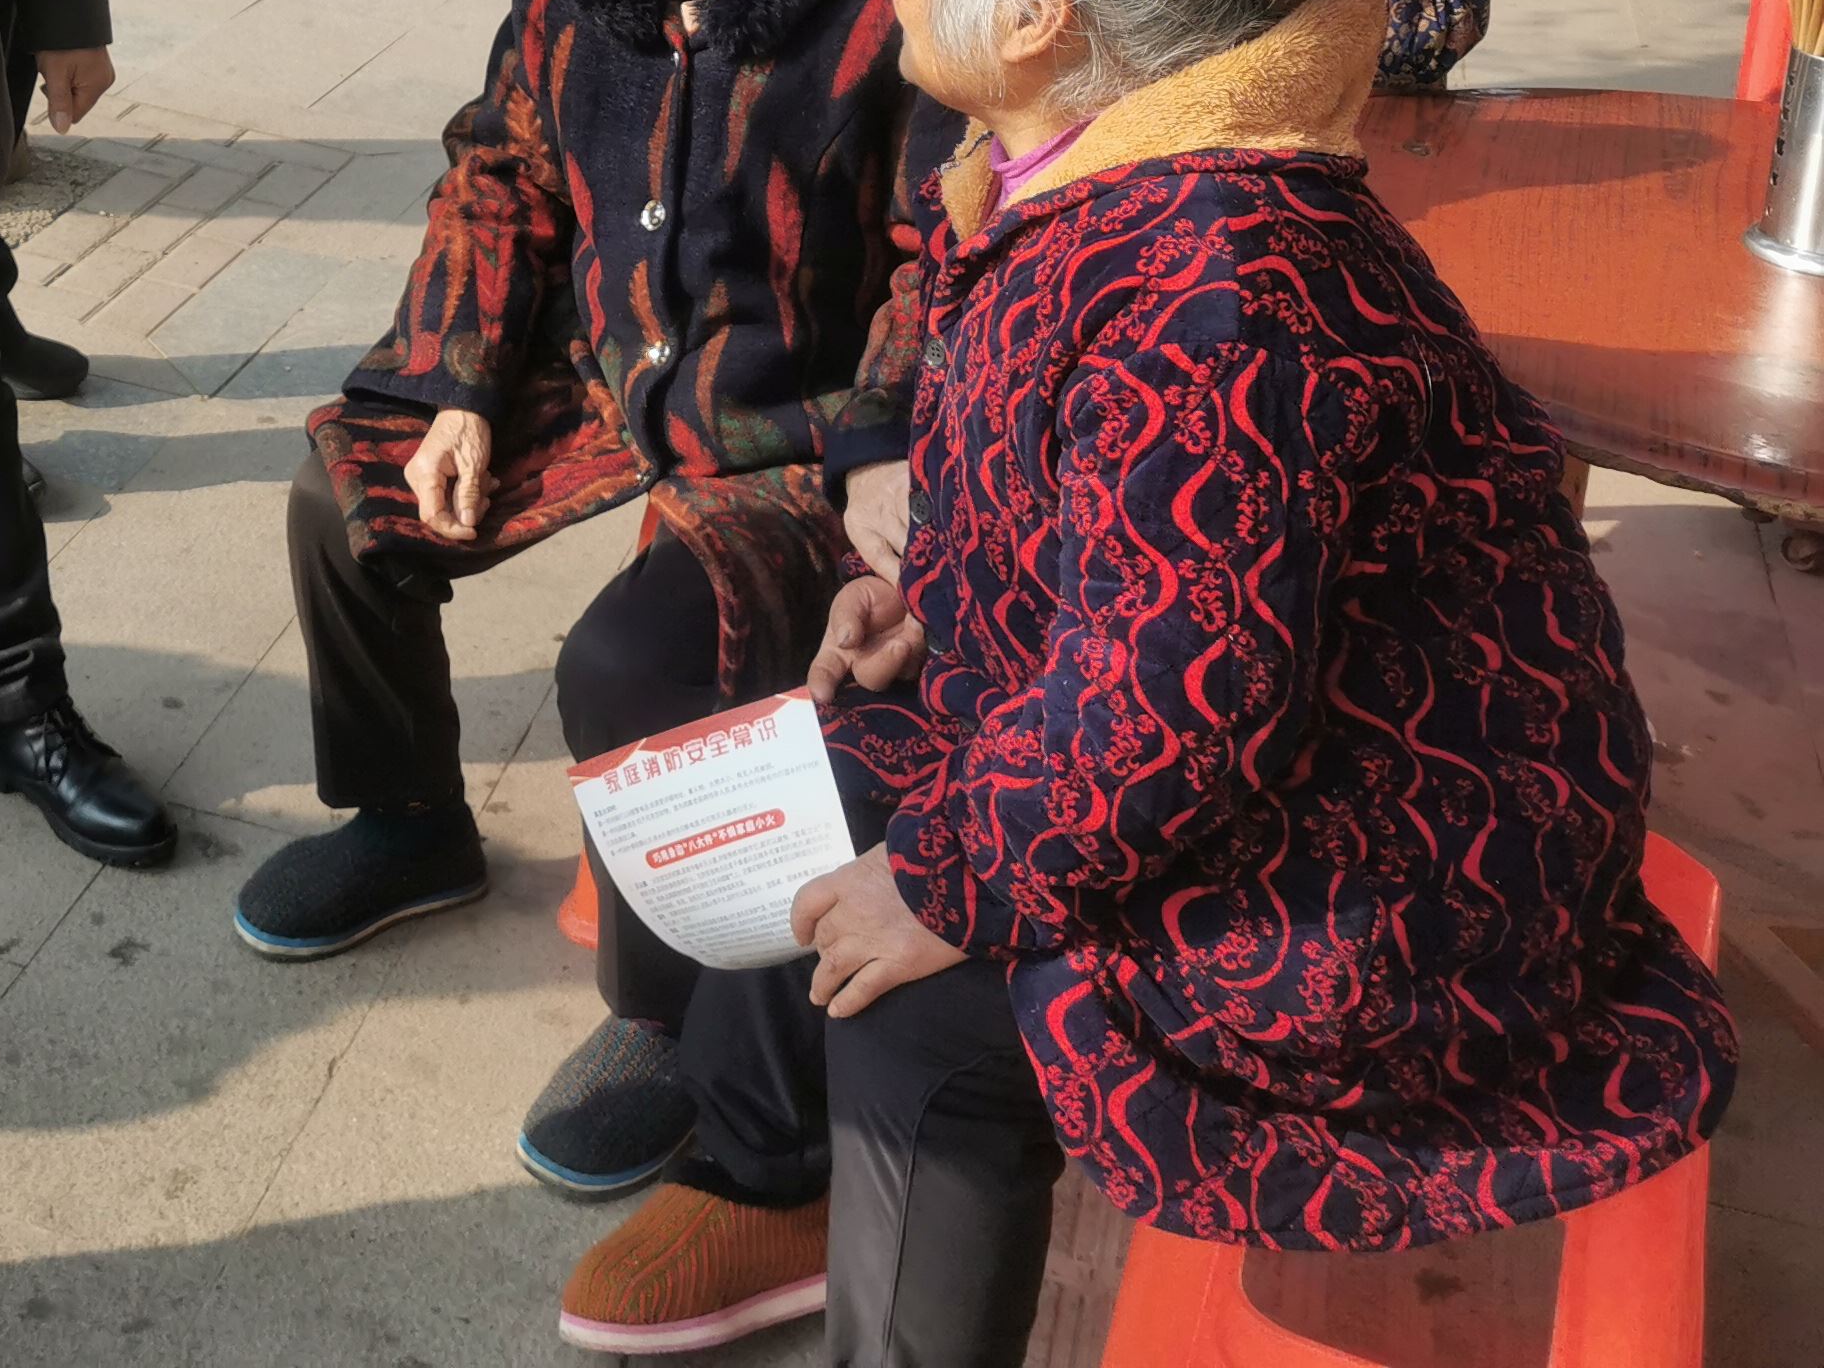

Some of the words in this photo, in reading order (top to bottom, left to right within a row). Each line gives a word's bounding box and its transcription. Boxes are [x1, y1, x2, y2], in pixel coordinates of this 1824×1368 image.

[603, 716, 778, 794] 家庭消防安全常识
